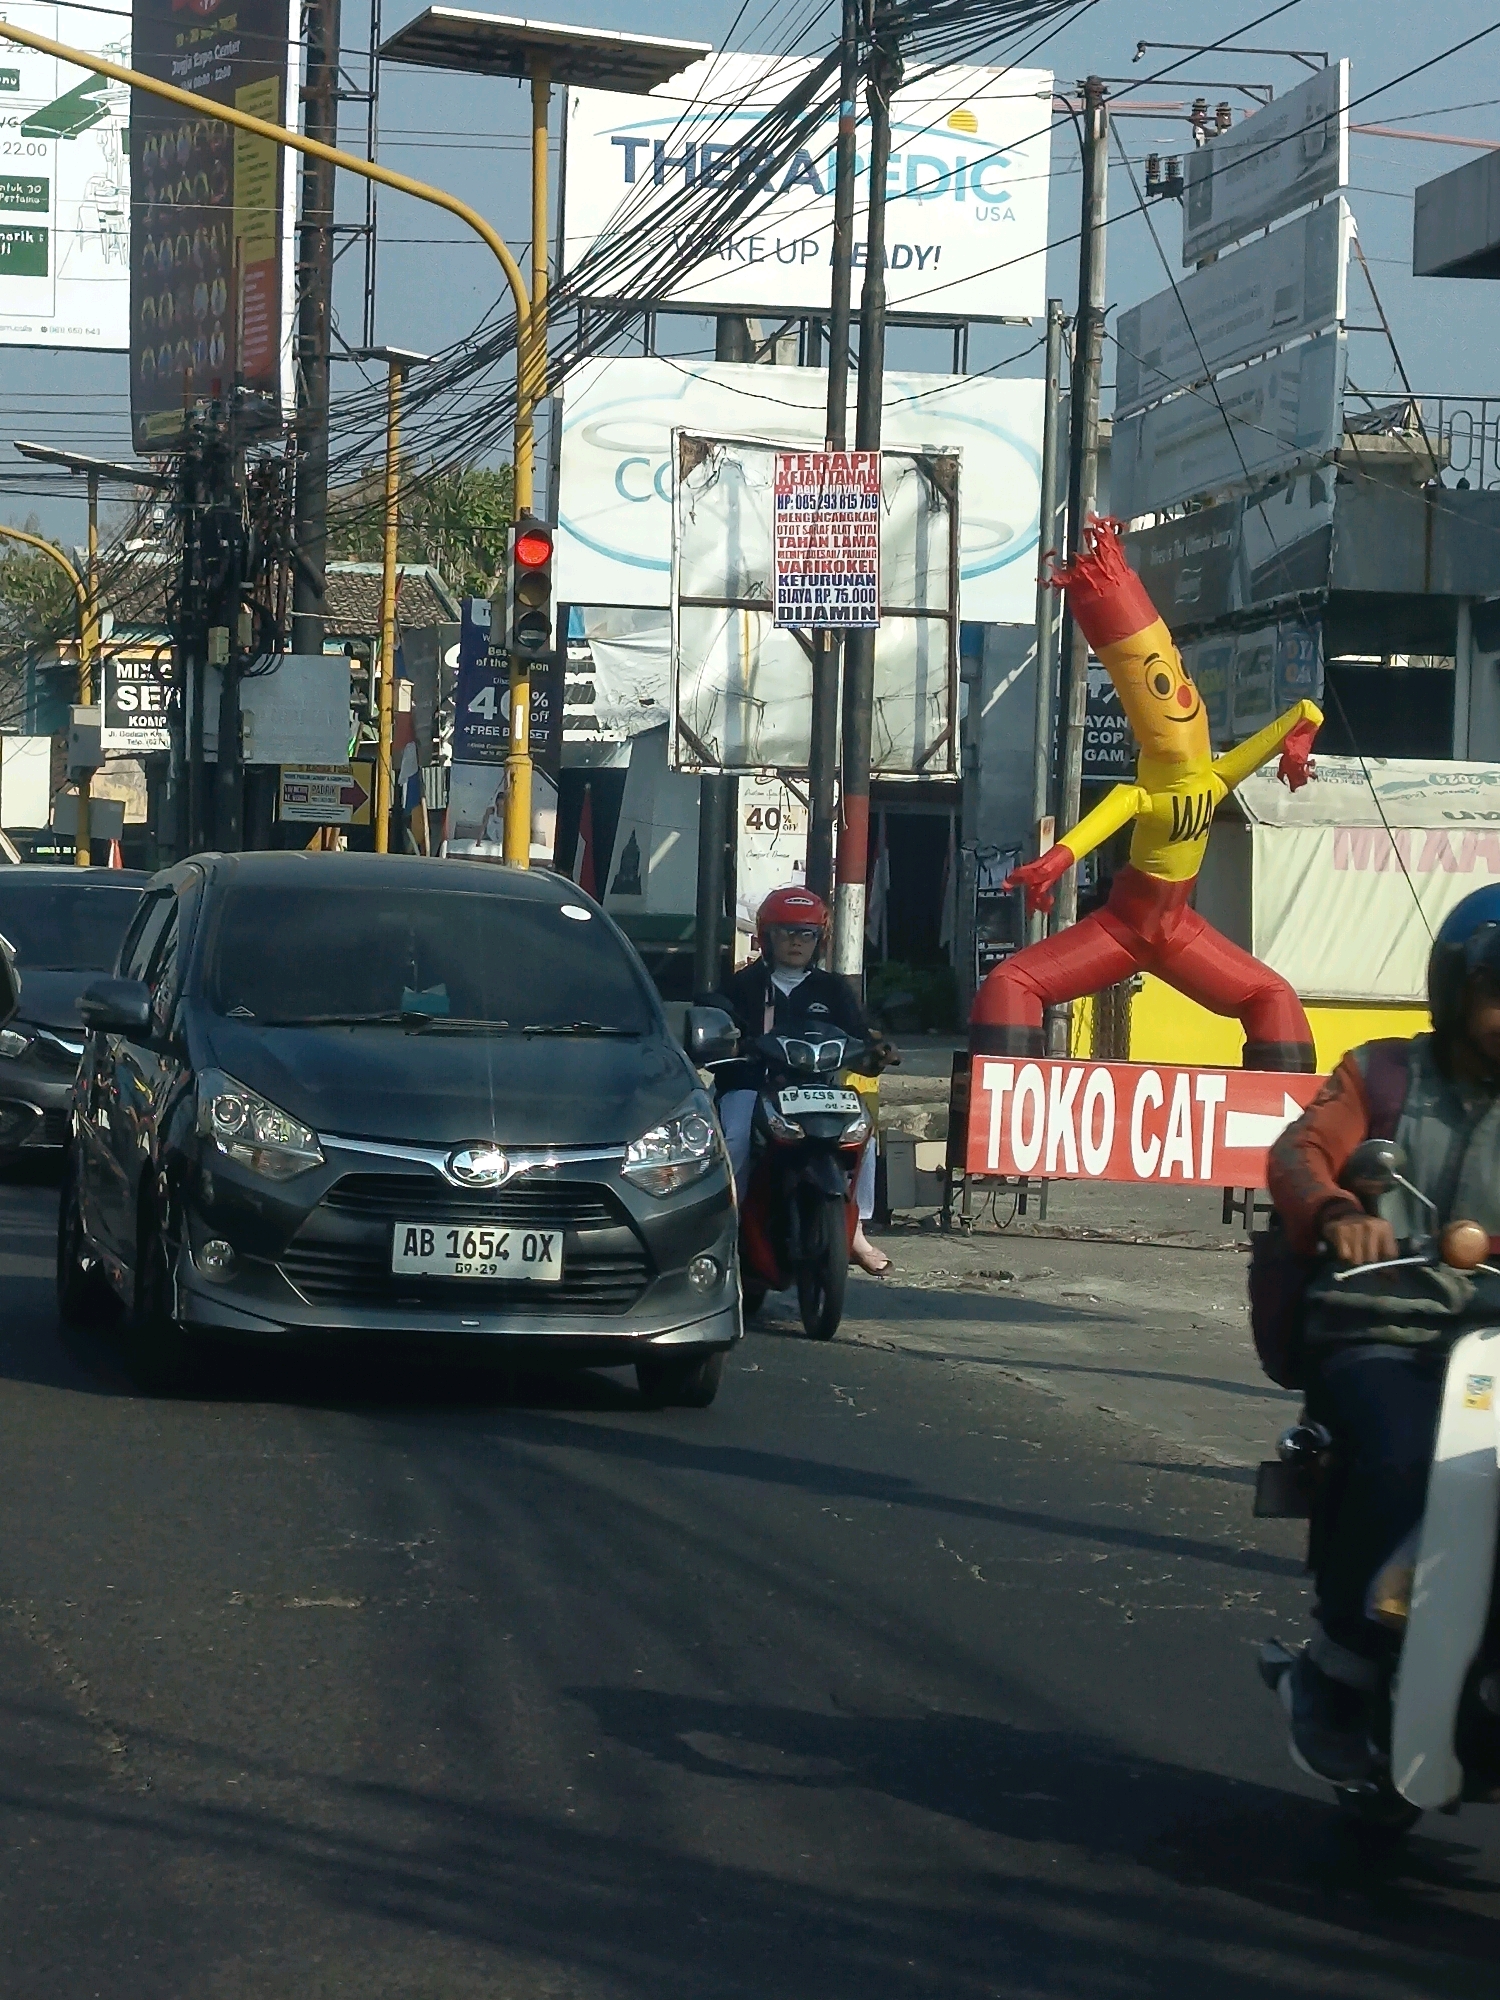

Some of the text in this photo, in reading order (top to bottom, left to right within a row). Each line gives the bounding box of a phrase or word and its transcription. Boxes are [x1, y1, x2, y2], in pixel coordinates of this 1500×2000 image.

[975, 206, 1016, 222] USA
[776, 236, 819, 264] UP
[780, 453, 878, 470] TERAPI
[779, 470, 878, 485] KEJANTANAN
[777, 494, 794, 510] HP:
[796, 493, 817, 510] 085
[860, 493, 878, 510] 769
[777, 525, 800, 535] OTOT
[831, 525, 851, 535] ALAT
[777, 536, 877, 548] TAHAN LAMA
[777, 559, 876, 573] VARIKOKEL
[778, 574, 876, 586] KETURUNAN
[778, 588, 876, 603] BIAYA RP. 75.000
[778, 606, 876, 620] DIJAMIN
[476, 658, 486, 667] of
[490, 658, 508, 668] the
[117, 664, 154, 679] MIX
[746, 808, 780, 830] 40
[982, 1062, 1227, 1180] TOKO CAT
[403, 1228, 554, 1262] AB 1654 OX
